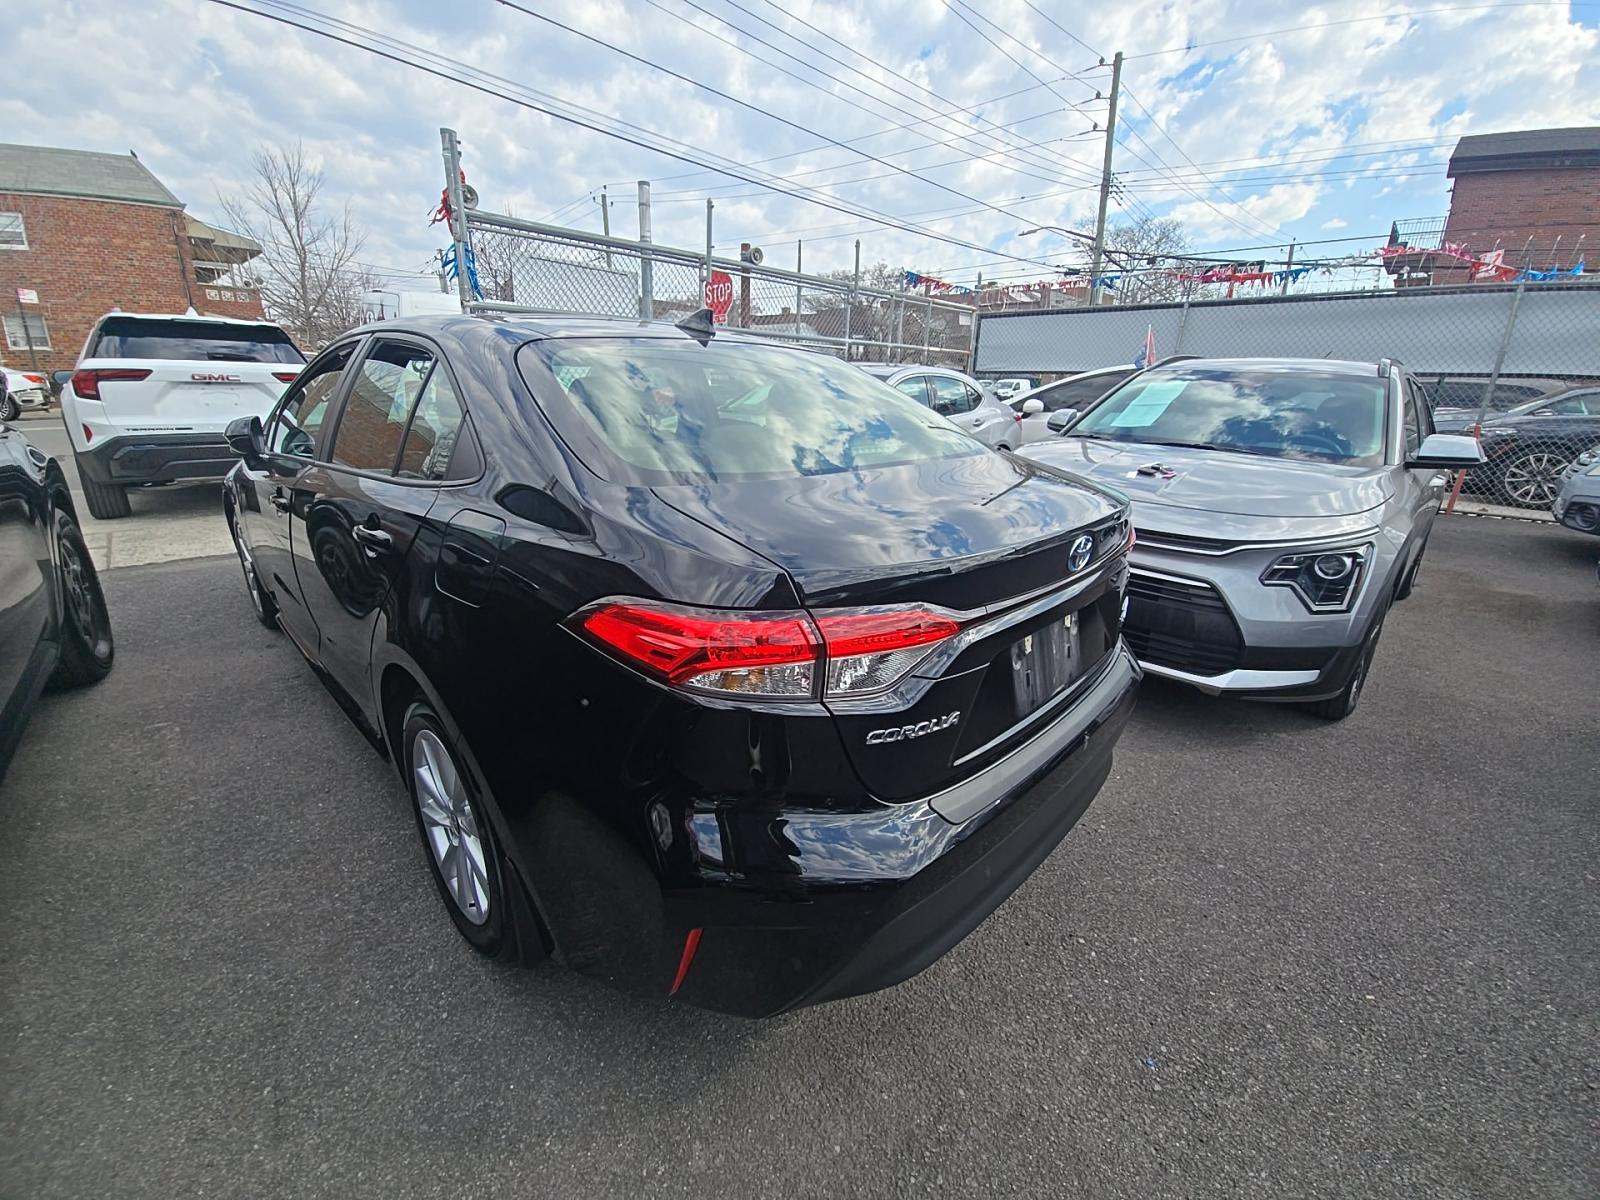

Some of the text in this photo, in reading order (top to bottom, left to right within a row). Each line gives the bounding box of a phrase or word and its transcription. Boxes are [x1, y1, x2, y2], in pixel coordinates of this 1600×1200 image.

[706, 282, 732, 304] STOP
[191, 373, 241, 382] GMC
[865, 711, 961, 745] COROLLA
